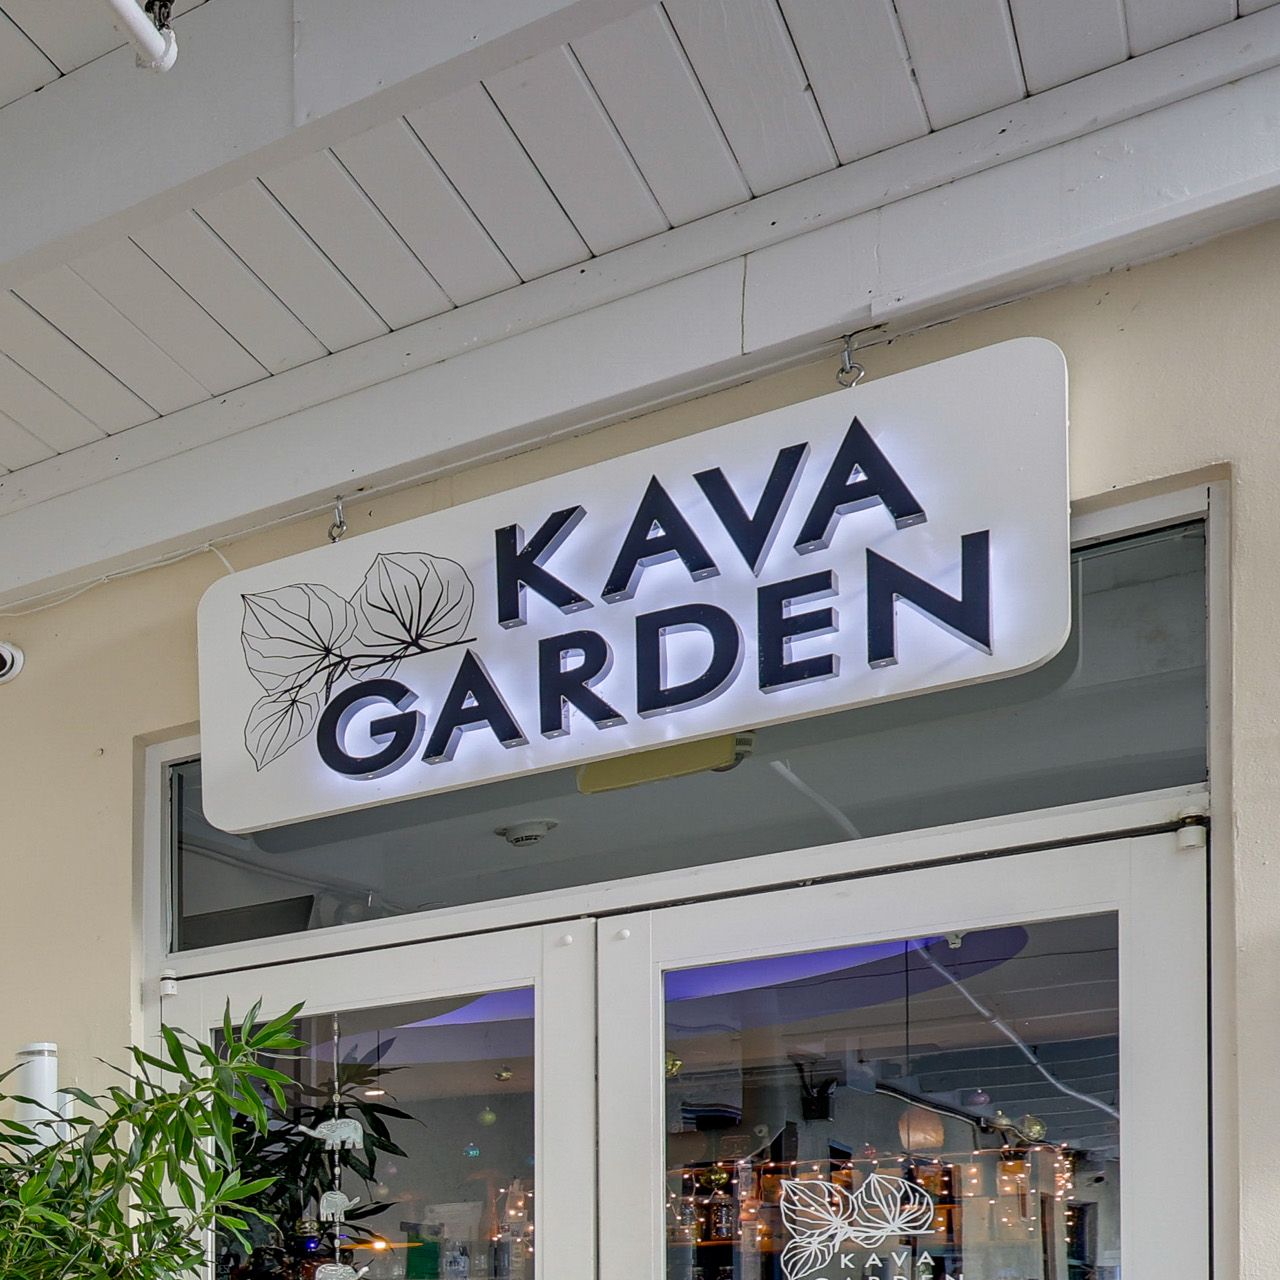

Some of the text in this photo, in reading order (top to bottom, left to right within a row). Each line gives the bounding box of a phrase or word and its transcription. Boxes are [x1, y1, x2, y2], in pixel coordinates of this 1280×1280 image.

[495, 416, 928, 630] KAVA
[317, 530, 993, 780] GARDEN
[840, 1251, 936, 1269] KAVA
